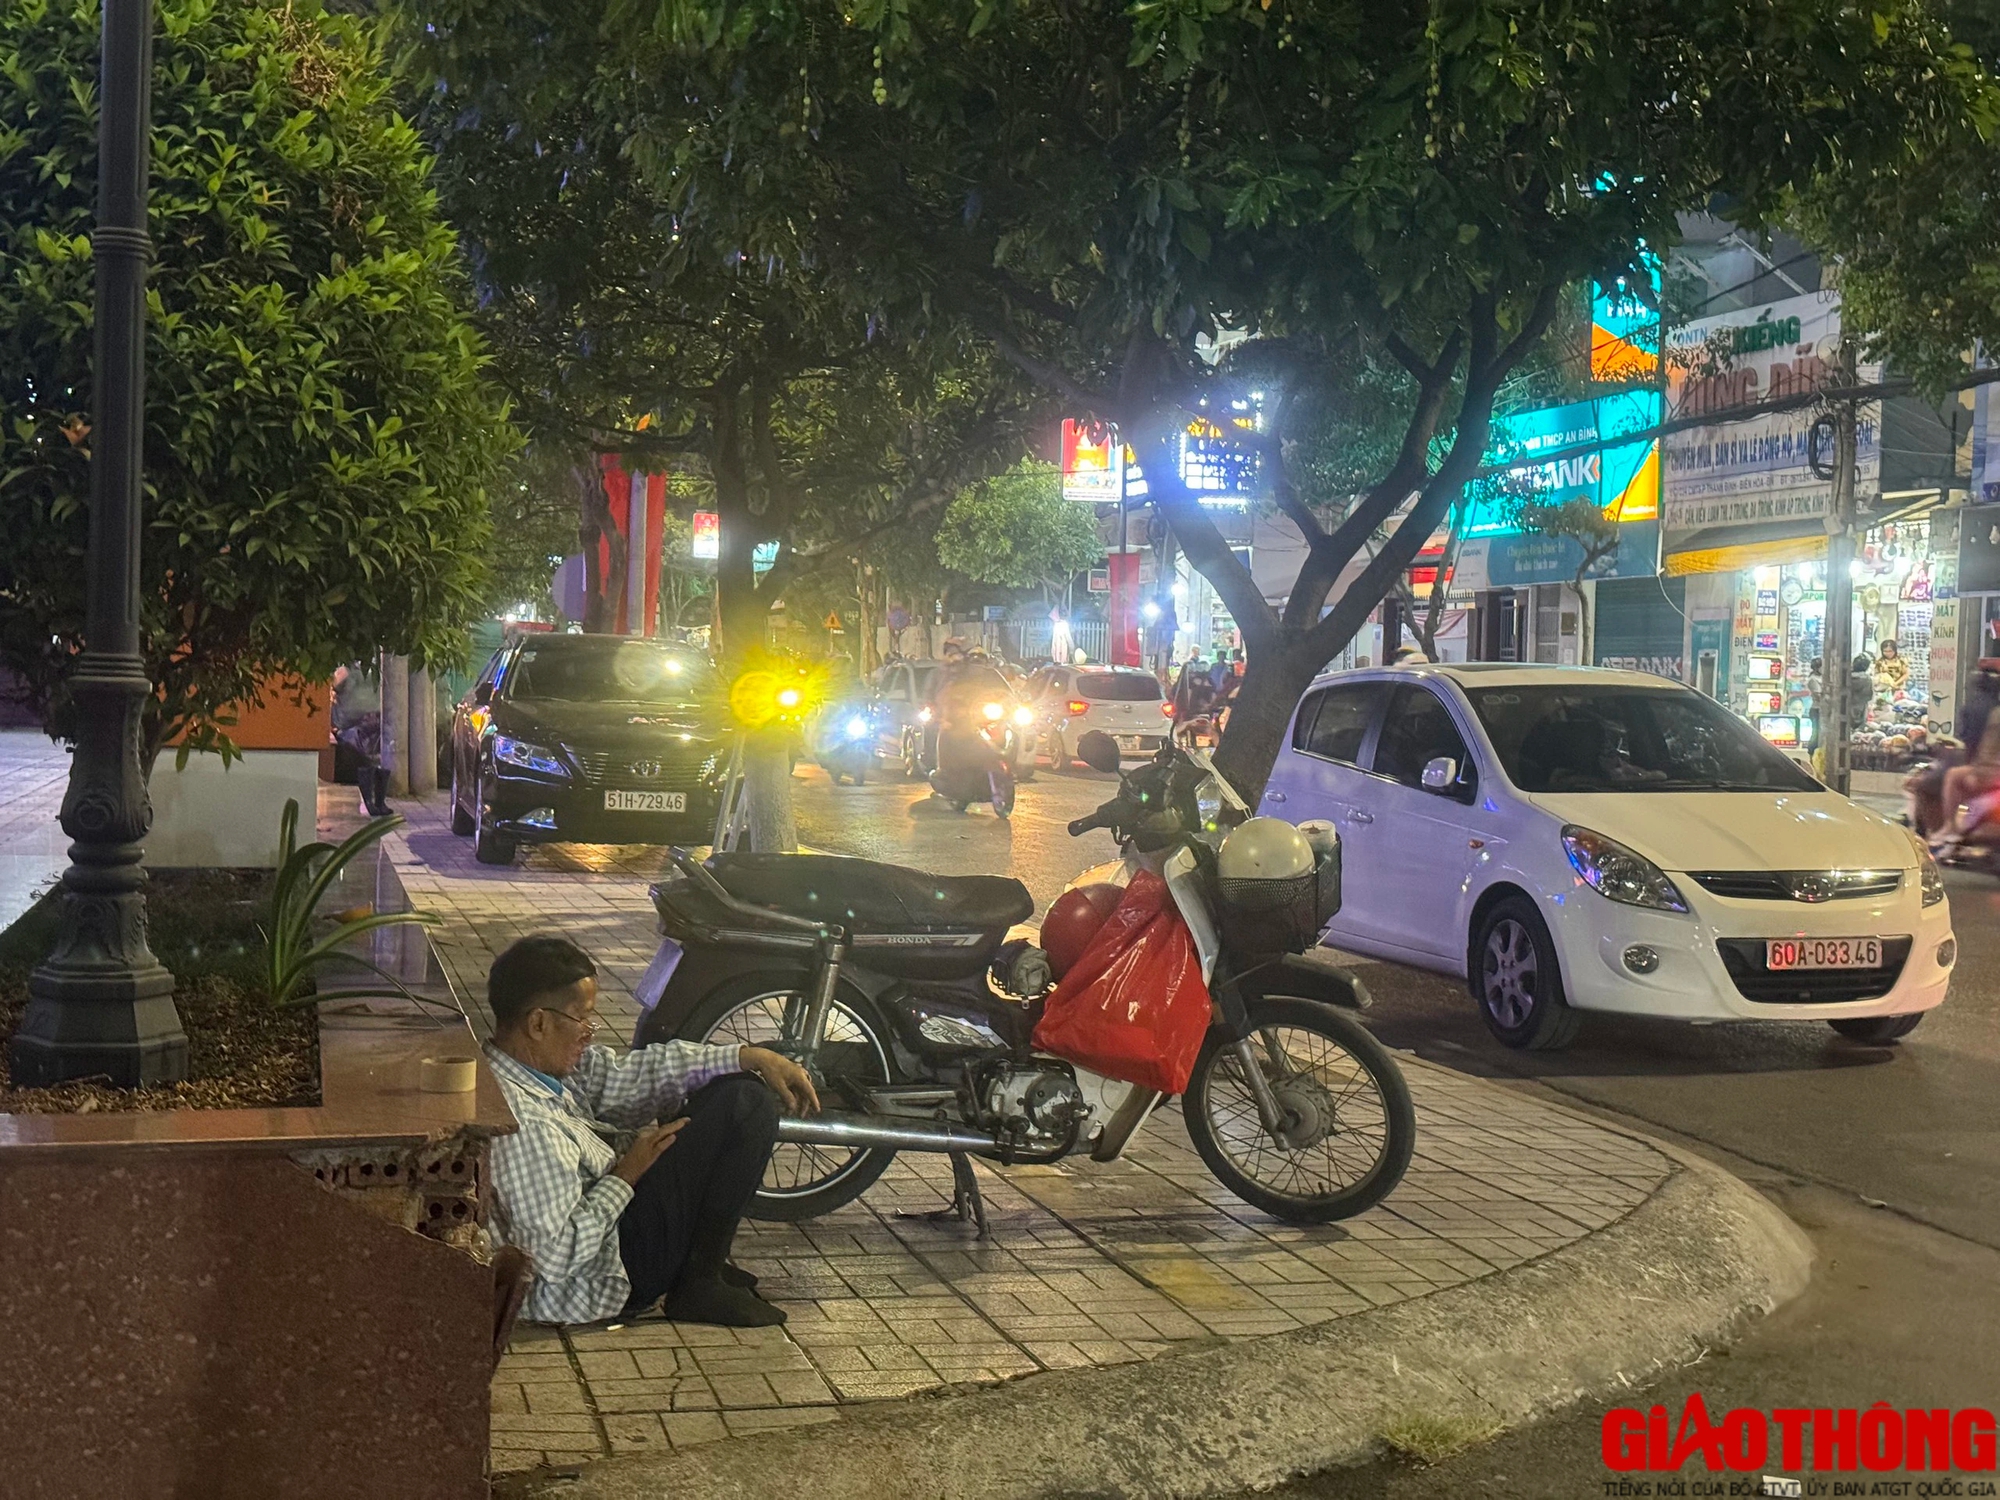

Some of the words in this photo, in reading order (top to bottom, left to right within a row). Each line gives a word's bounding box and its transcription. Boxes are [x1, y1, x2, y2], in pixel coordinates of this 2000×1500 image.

[1543, 433, 1564, 447] TMCP
[1566, 430, 1577, 444] AN
[1933, 622, 1955, 639] KÍNH
[607, 793, 683, 810] 51H-729.46
[887, 937, 932, 945] HONDA
[1771, 941, 1877, 966] 60A-033.46
